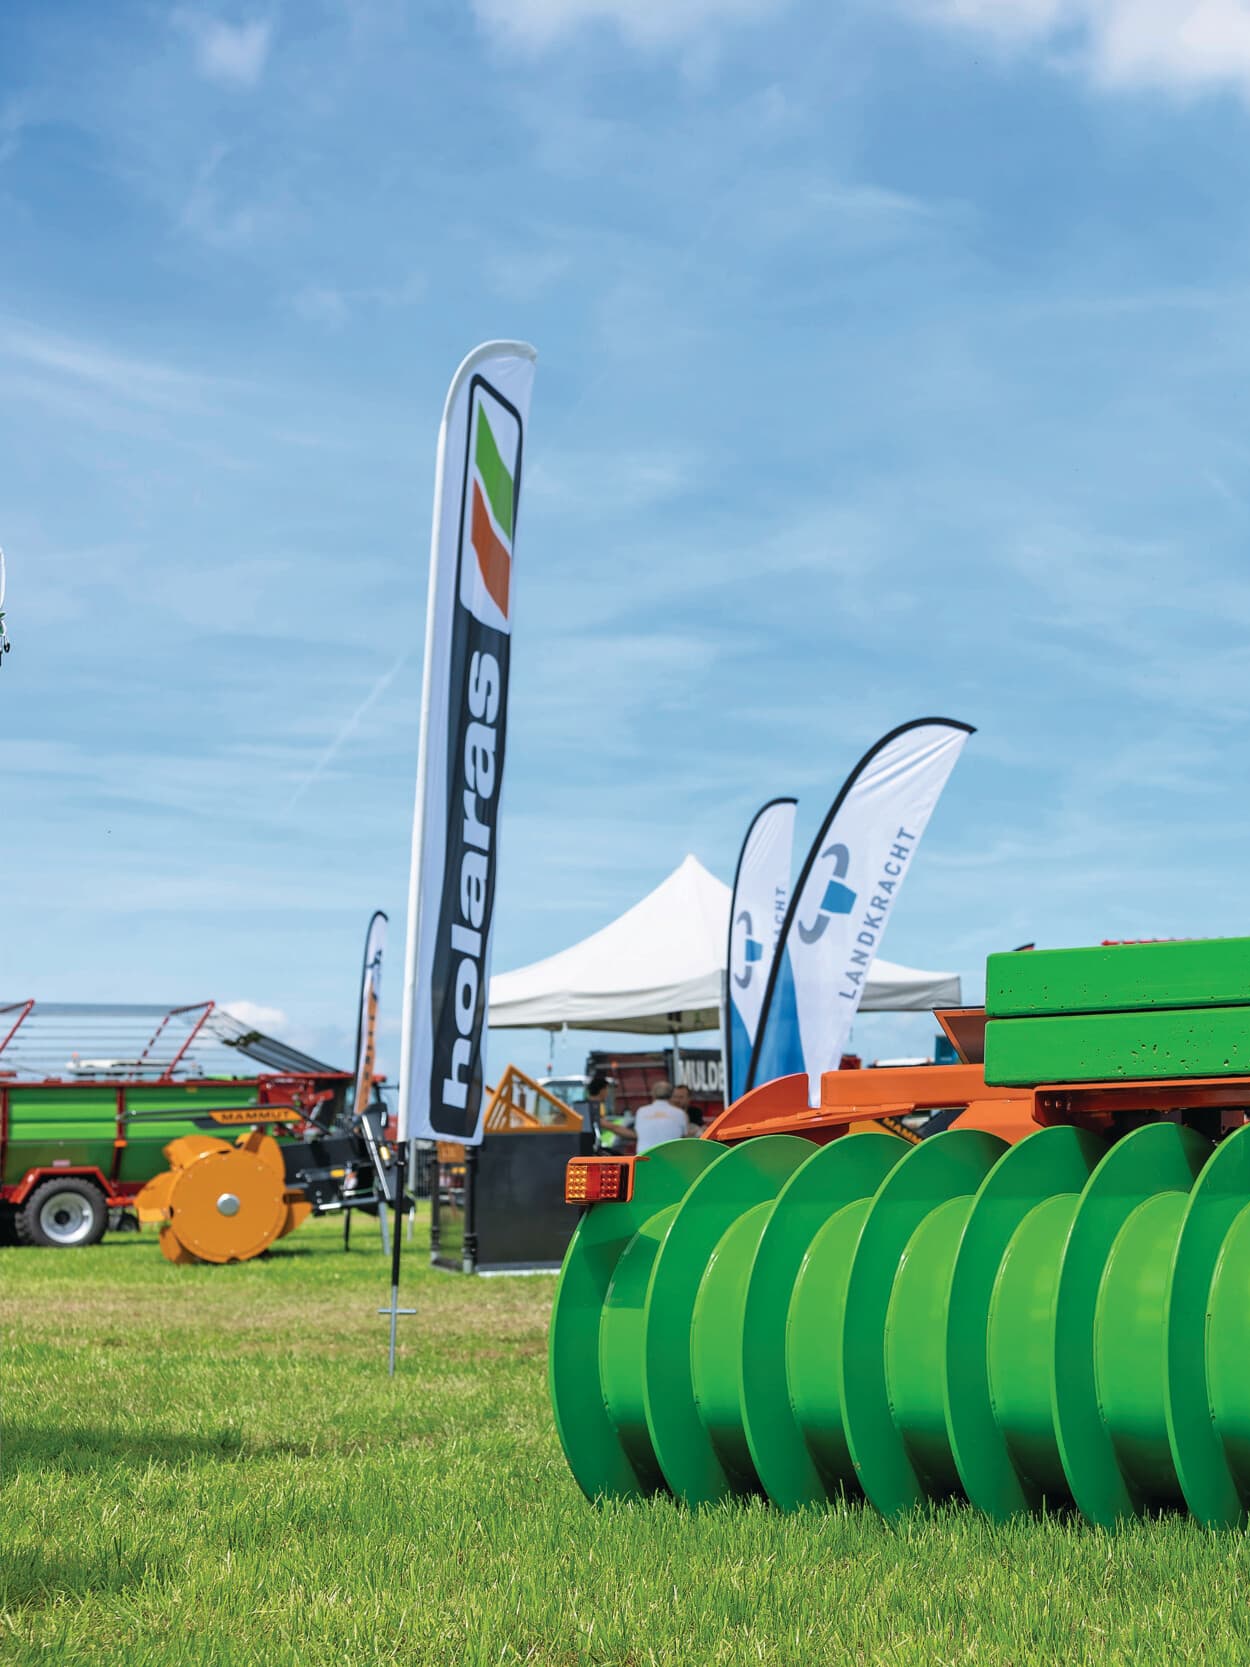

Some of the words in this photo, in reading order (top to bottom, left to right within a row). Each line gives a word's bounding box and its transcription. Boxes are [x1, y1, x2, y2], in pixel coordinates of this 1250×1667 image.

[441, 649, 501, 1109] holaras
[838, 826, 916, 1001] LANDKRACHT
[221, 1110, 289, 1121] MAMMUT
